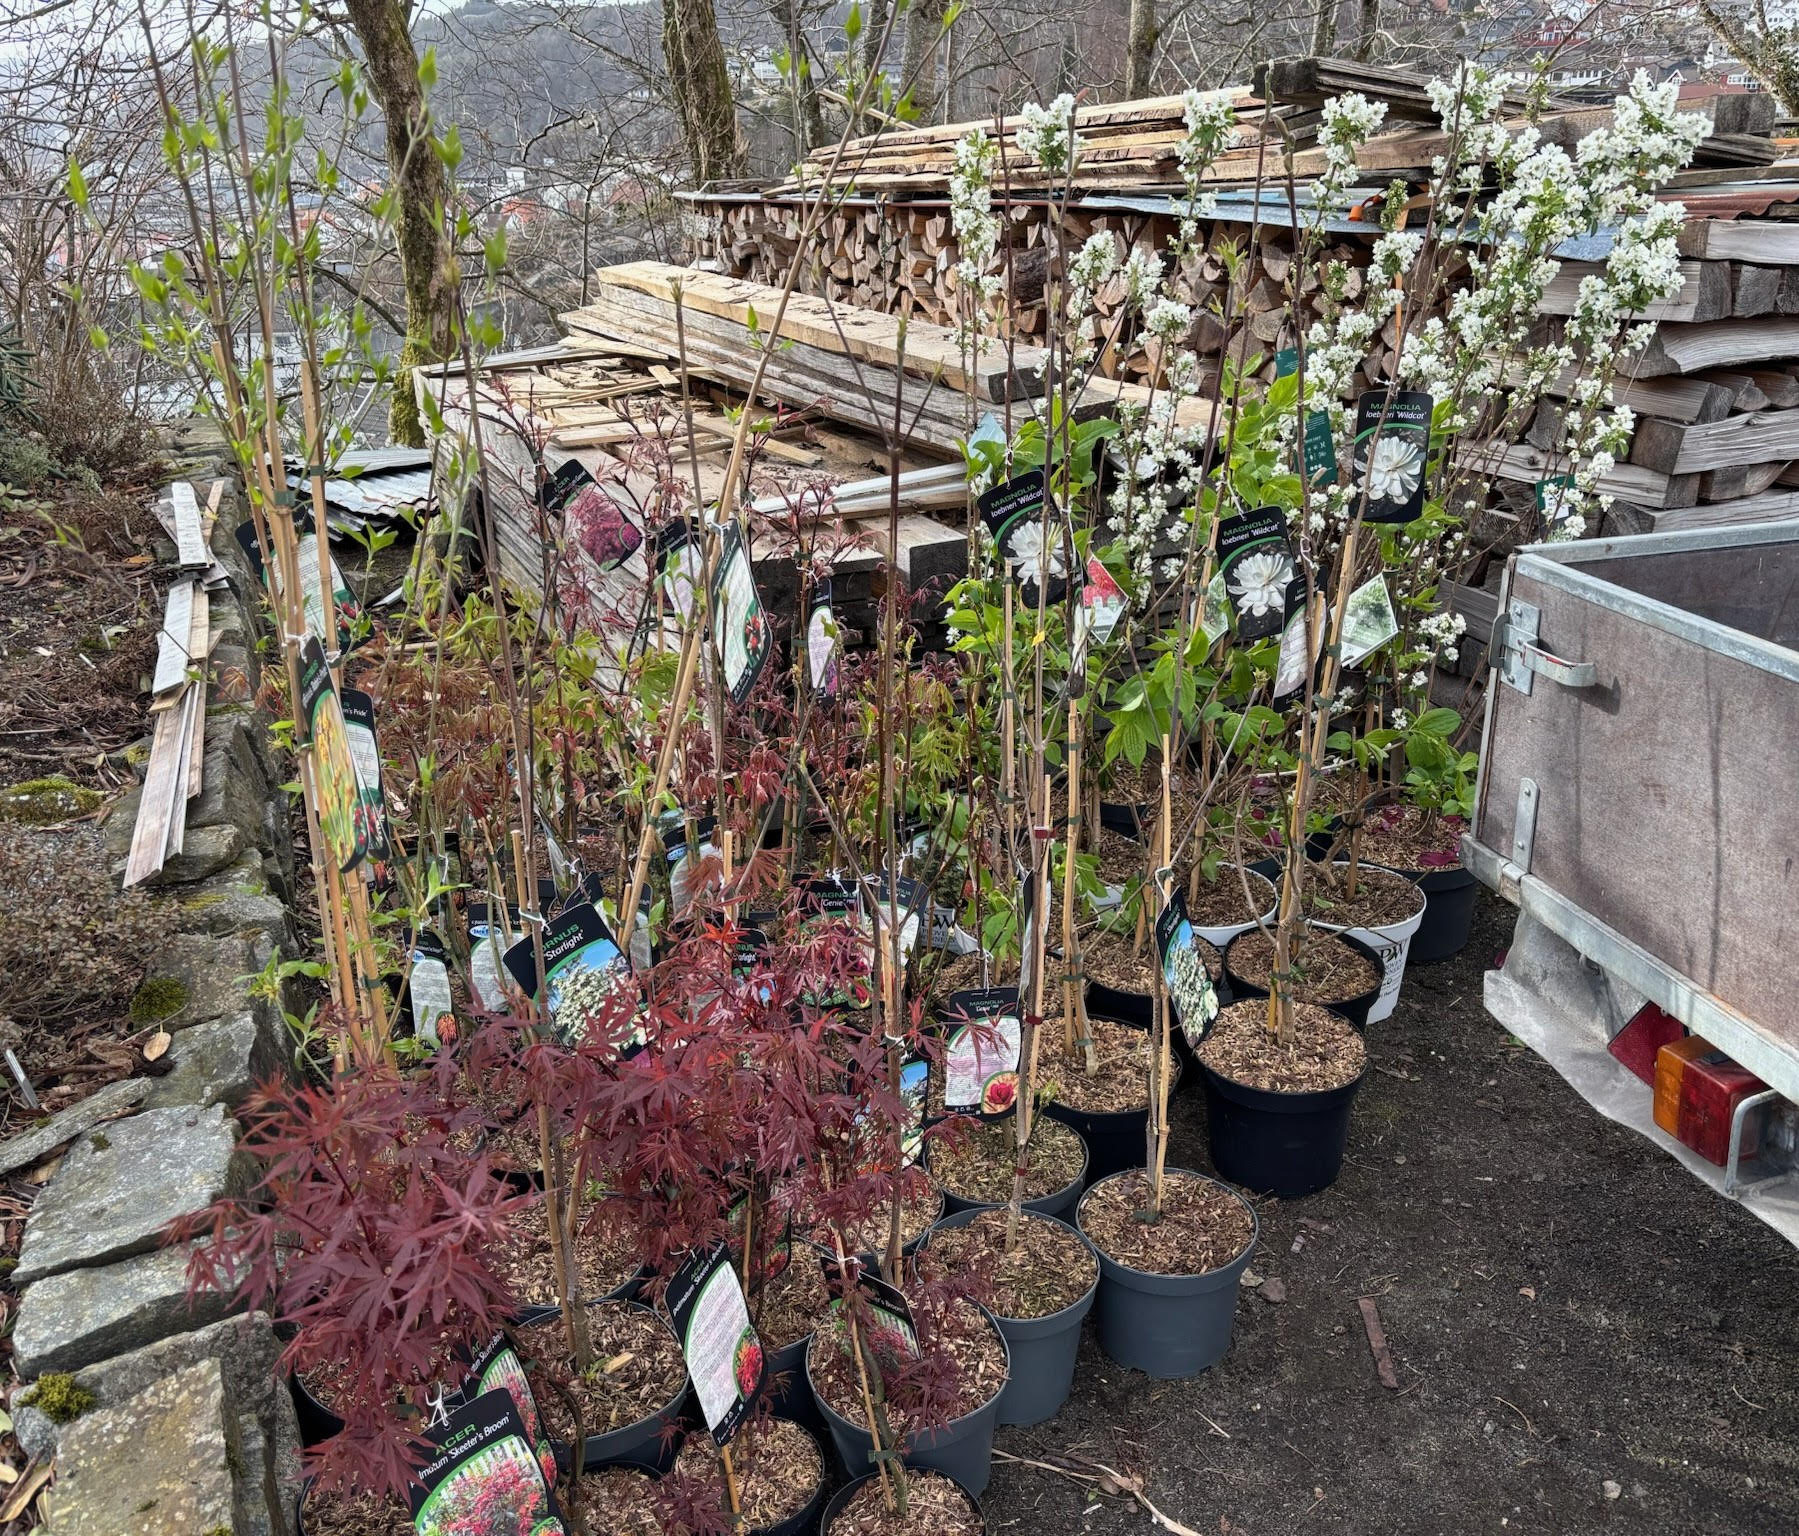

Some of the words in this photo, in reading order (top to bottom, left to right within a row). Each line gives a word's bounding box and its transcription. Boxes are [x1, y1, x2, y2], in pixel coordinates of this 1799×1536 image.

[990, 483, 1037, 509] MAGNOLIA
[1222, 518, 1273, 537] MAGNOLIA
[969, 999, 1005, 1007] MAGNOLIA
[435, 1423, 477, 1456] ACER
[448, 1432, 484, 1460] 'Skeeter's
[482, 1411, 511, 1438] Broom'
